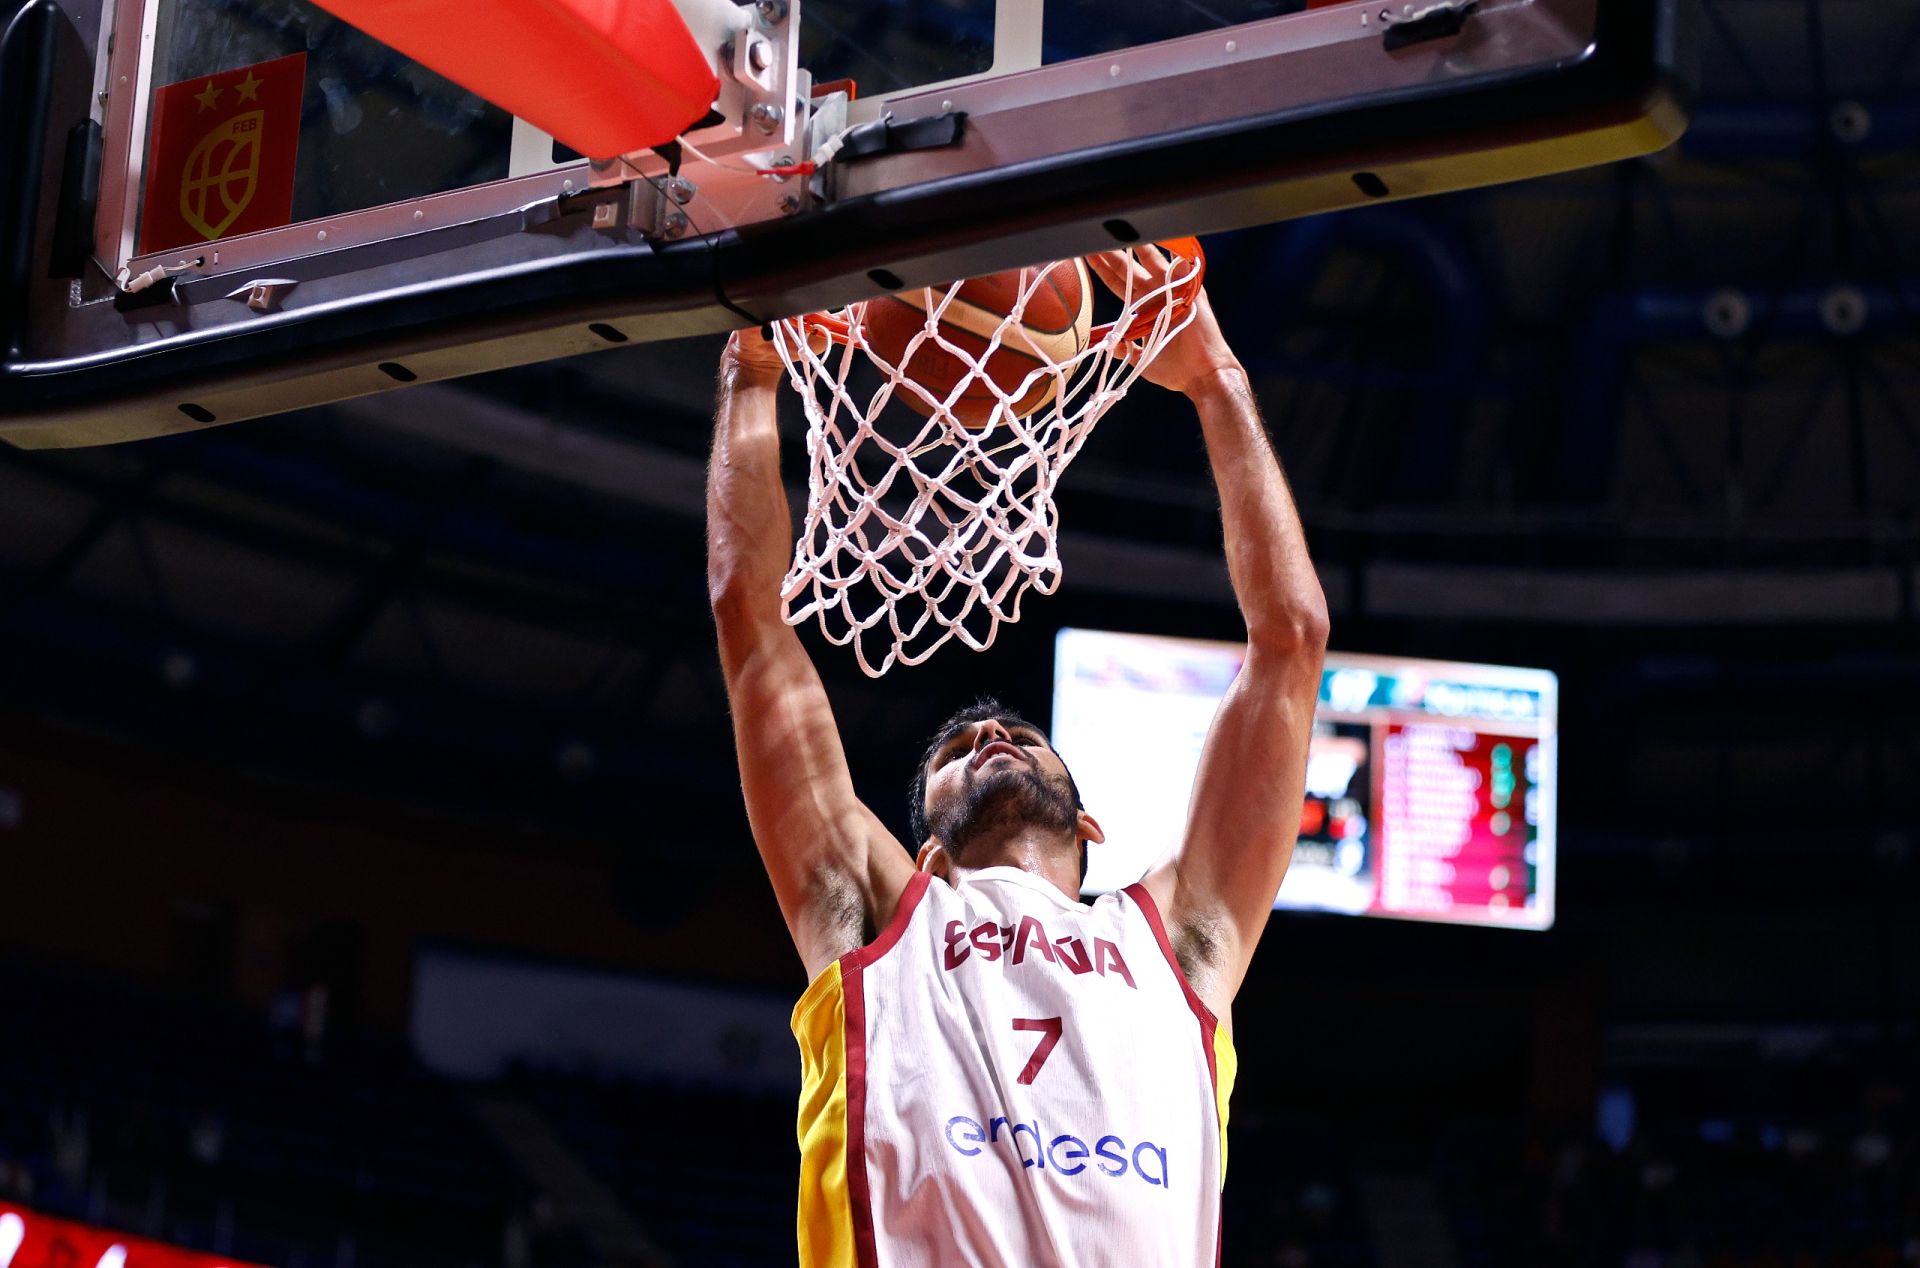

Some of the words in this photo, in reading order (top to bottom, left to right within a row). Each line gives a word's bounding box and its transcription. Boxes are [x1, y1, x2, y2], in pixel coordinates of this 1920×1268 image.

[233, 118, 258, 135] FEB
[1012, 1016, 1063, 1085] 7
[945, 1115, 1168, 1189] endesa
